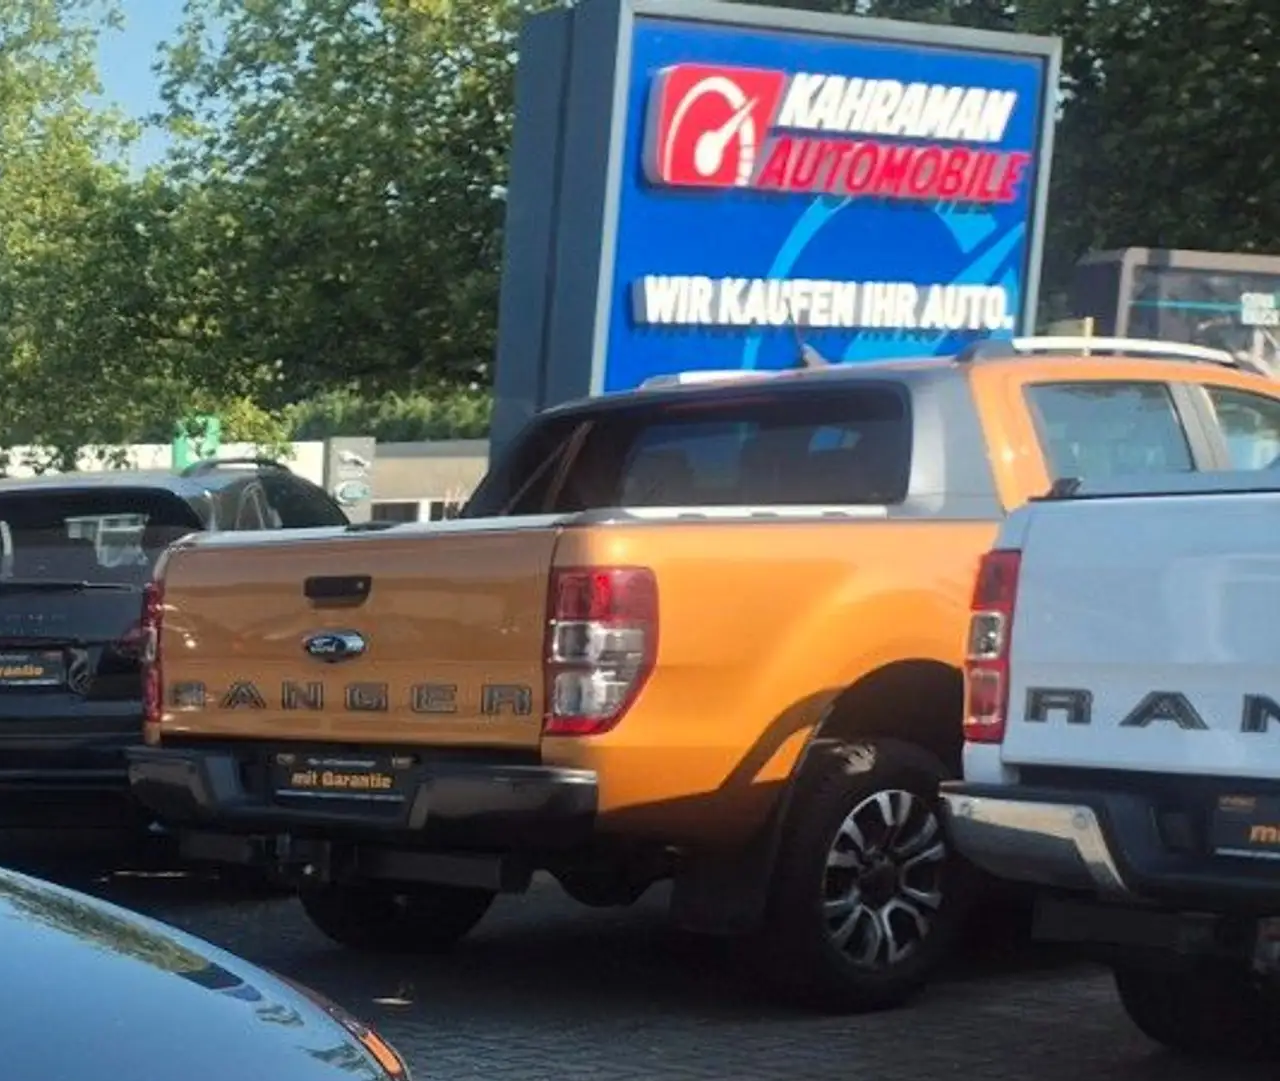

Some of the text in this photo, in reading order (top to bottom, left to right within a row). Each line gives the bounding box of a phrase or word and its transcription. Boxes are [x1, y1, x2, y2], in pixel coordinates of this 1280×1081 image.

[778, 72, 1018, 142] KAHRAMAN
[757, 136, 1033, 202] AUTOMOBILE
[644, 275, 712, 324] WIR
[717, 278, 856, 327] KAUFEN
[862, 281, 923, 329] IHR
[171, 680, 534, 717] RANGER
[291, 771, 393, 789] mit Garantie
